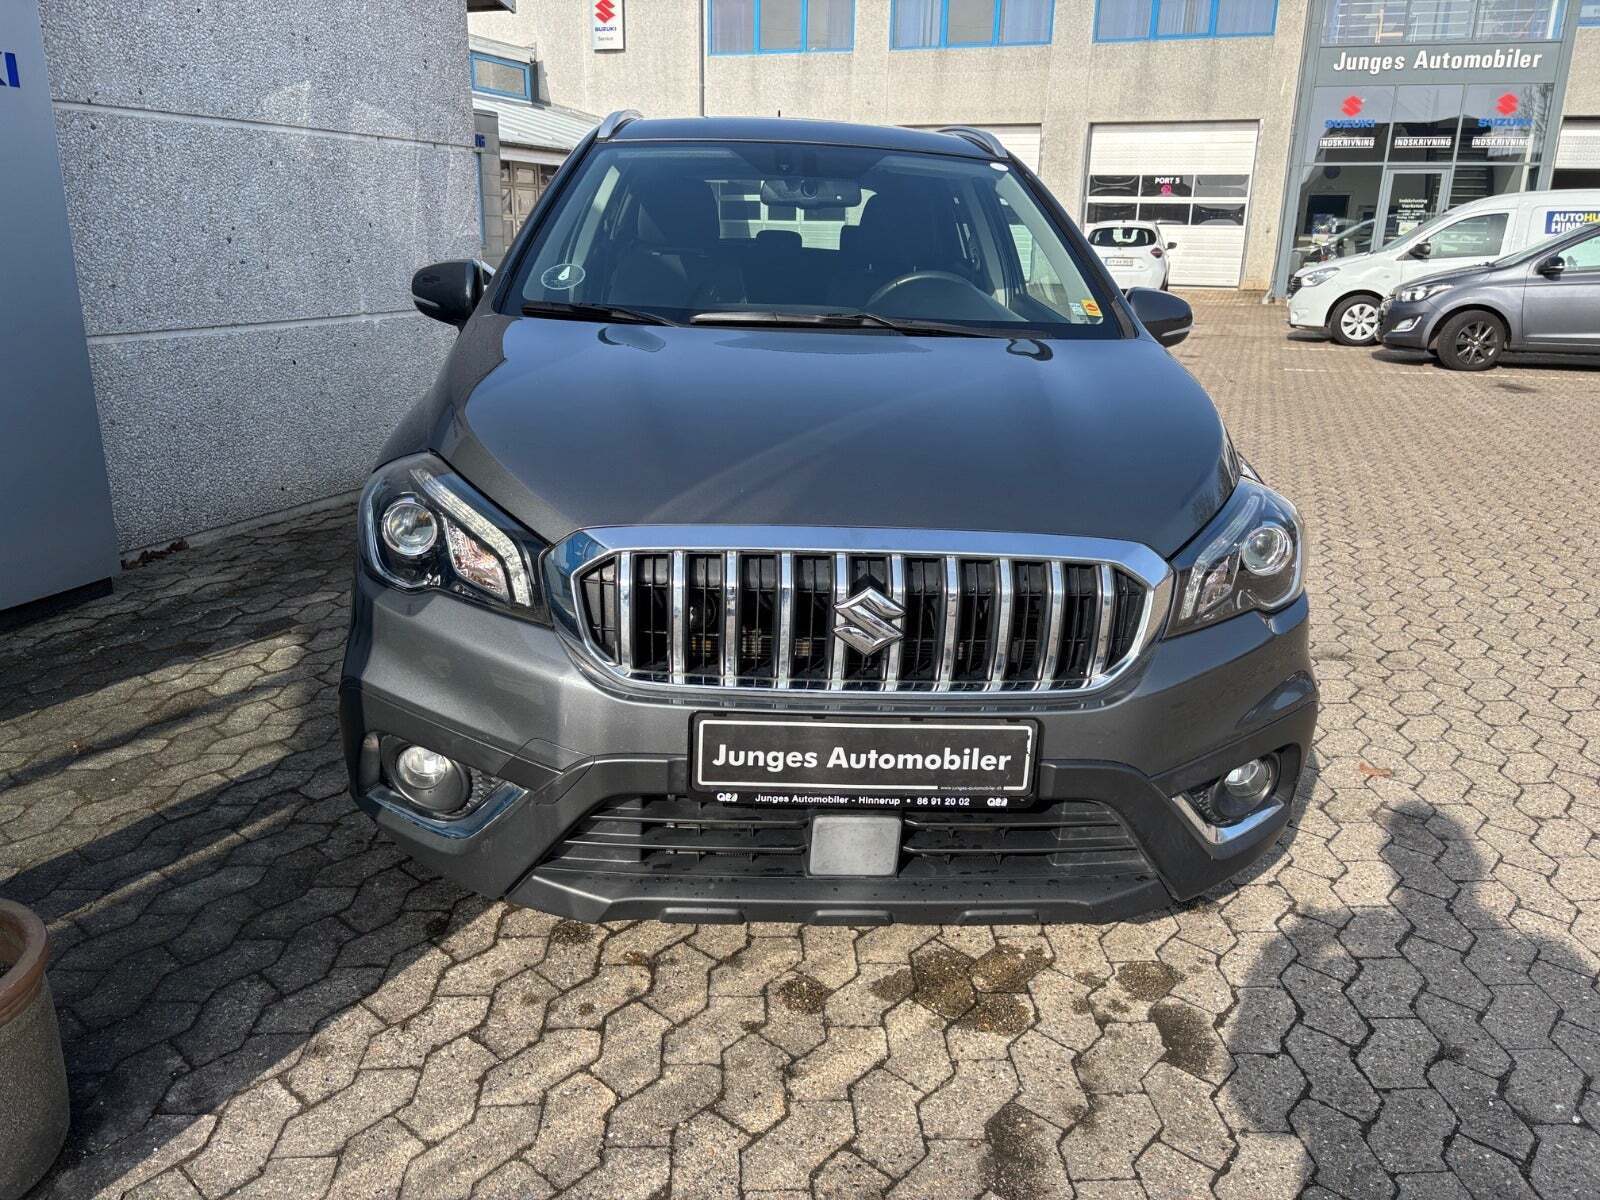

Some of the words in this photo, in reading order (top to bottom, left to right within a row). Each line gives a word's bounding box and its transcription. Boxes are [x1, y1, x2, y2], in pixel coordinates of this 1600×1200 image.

[1333, 51, 1405, 74] Junges
[1413, 49, 1542, 69] Automobiler
[1324, 119, 1376, 128] SUZUKI
[1478, 118, 1533, 127] SUZUKI
[1320, 138, 1374, 147] INDSKRIVNING
[1395, 138, 1451, 147] INDSKRIVNING
[1472, 138, 1531, 147] INDSKRIVNING
[712, 743, 818, 772] Junges
[826, 747, 1011, 771] Automobiler
[755, 794, 789, 804] Junges
[792, 794, 848, 804] Automobiler
[858, 795, 900, 806] Hinnerup
[917, 797, 927, 805] 86
[931, 797, 941, 805] 91
[945, 797, 956, 805] 20
[959, 797, 970, 806] 02
